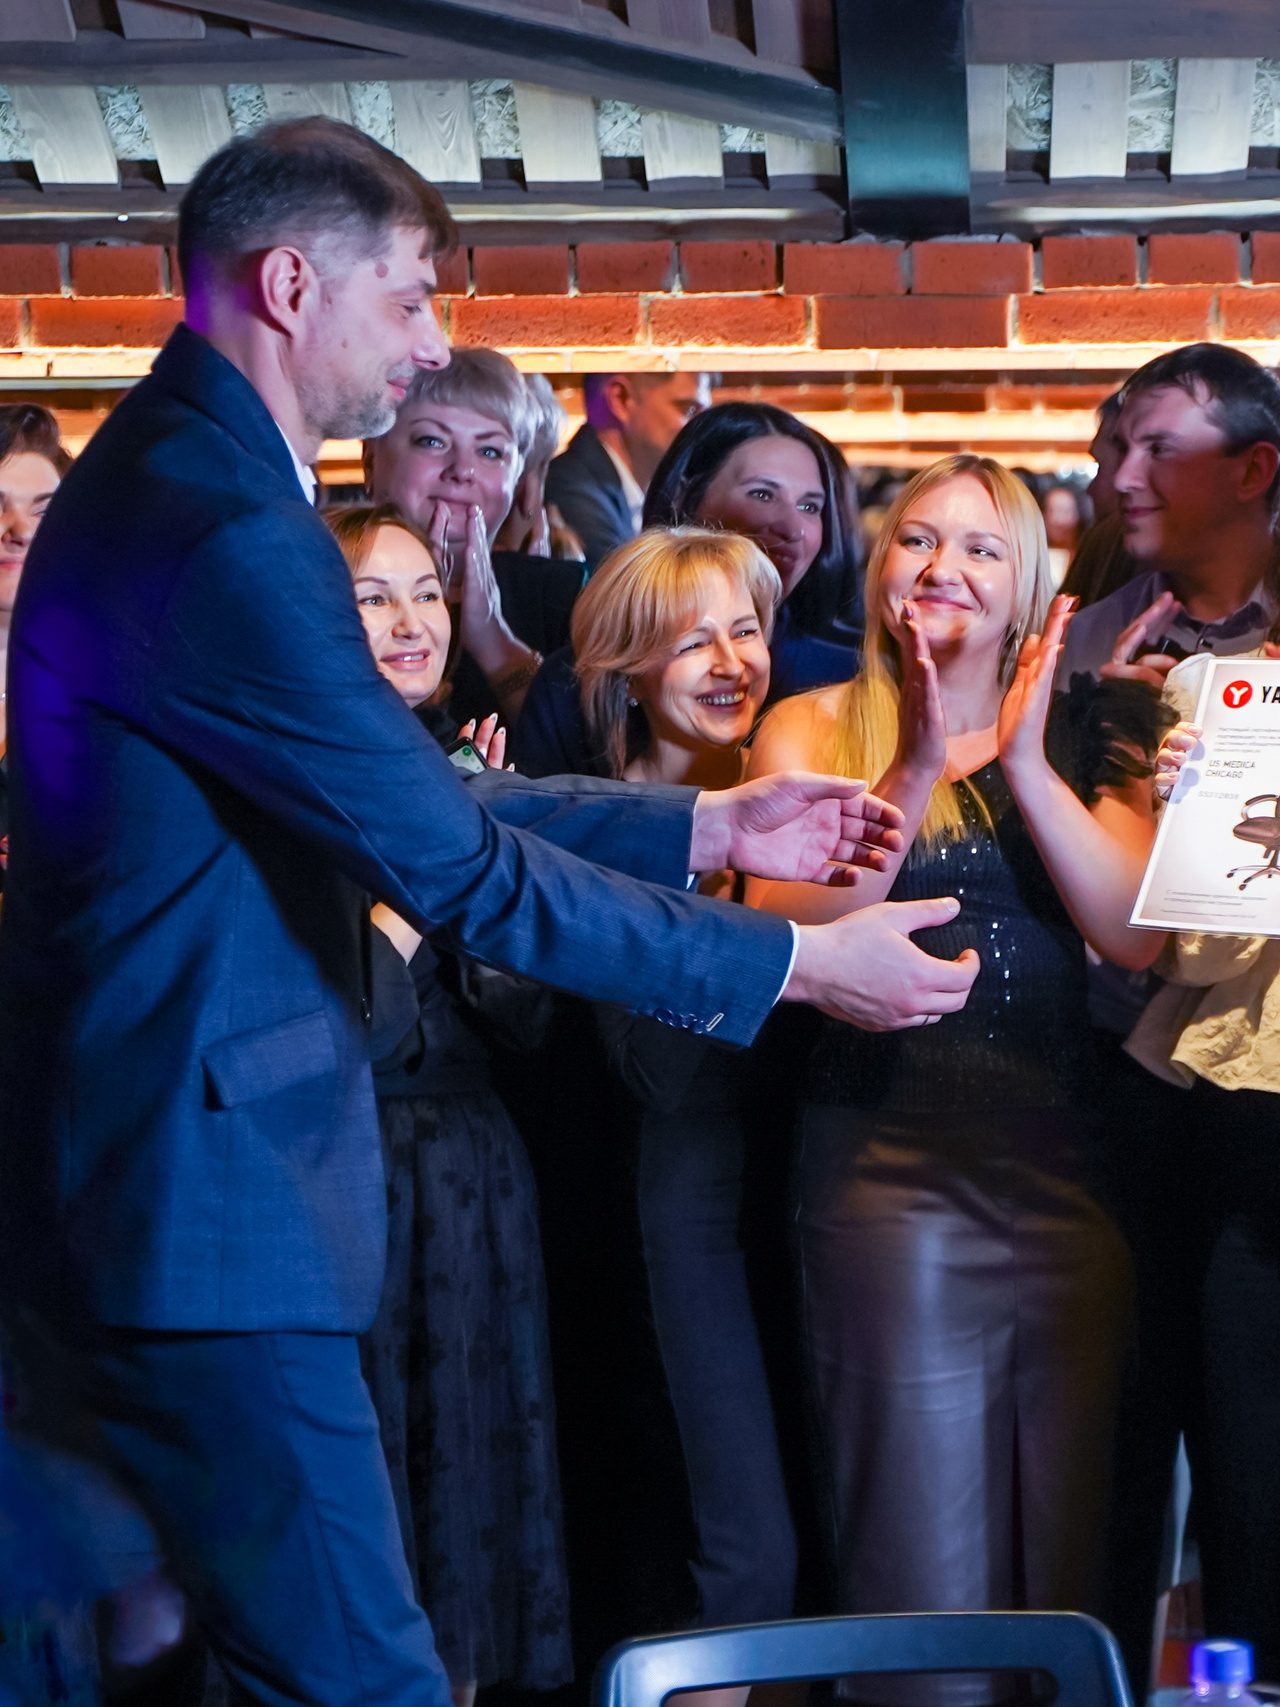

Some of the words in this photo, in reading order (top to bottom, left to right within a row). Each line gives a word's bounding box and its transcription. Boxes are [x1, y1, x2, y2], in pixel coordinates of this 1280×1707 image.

[1208, 759, 1221, 768] US
[1223, 760, 1256, 769] MEDICA
[1205, 769, 1244, 779] CHICAGO
